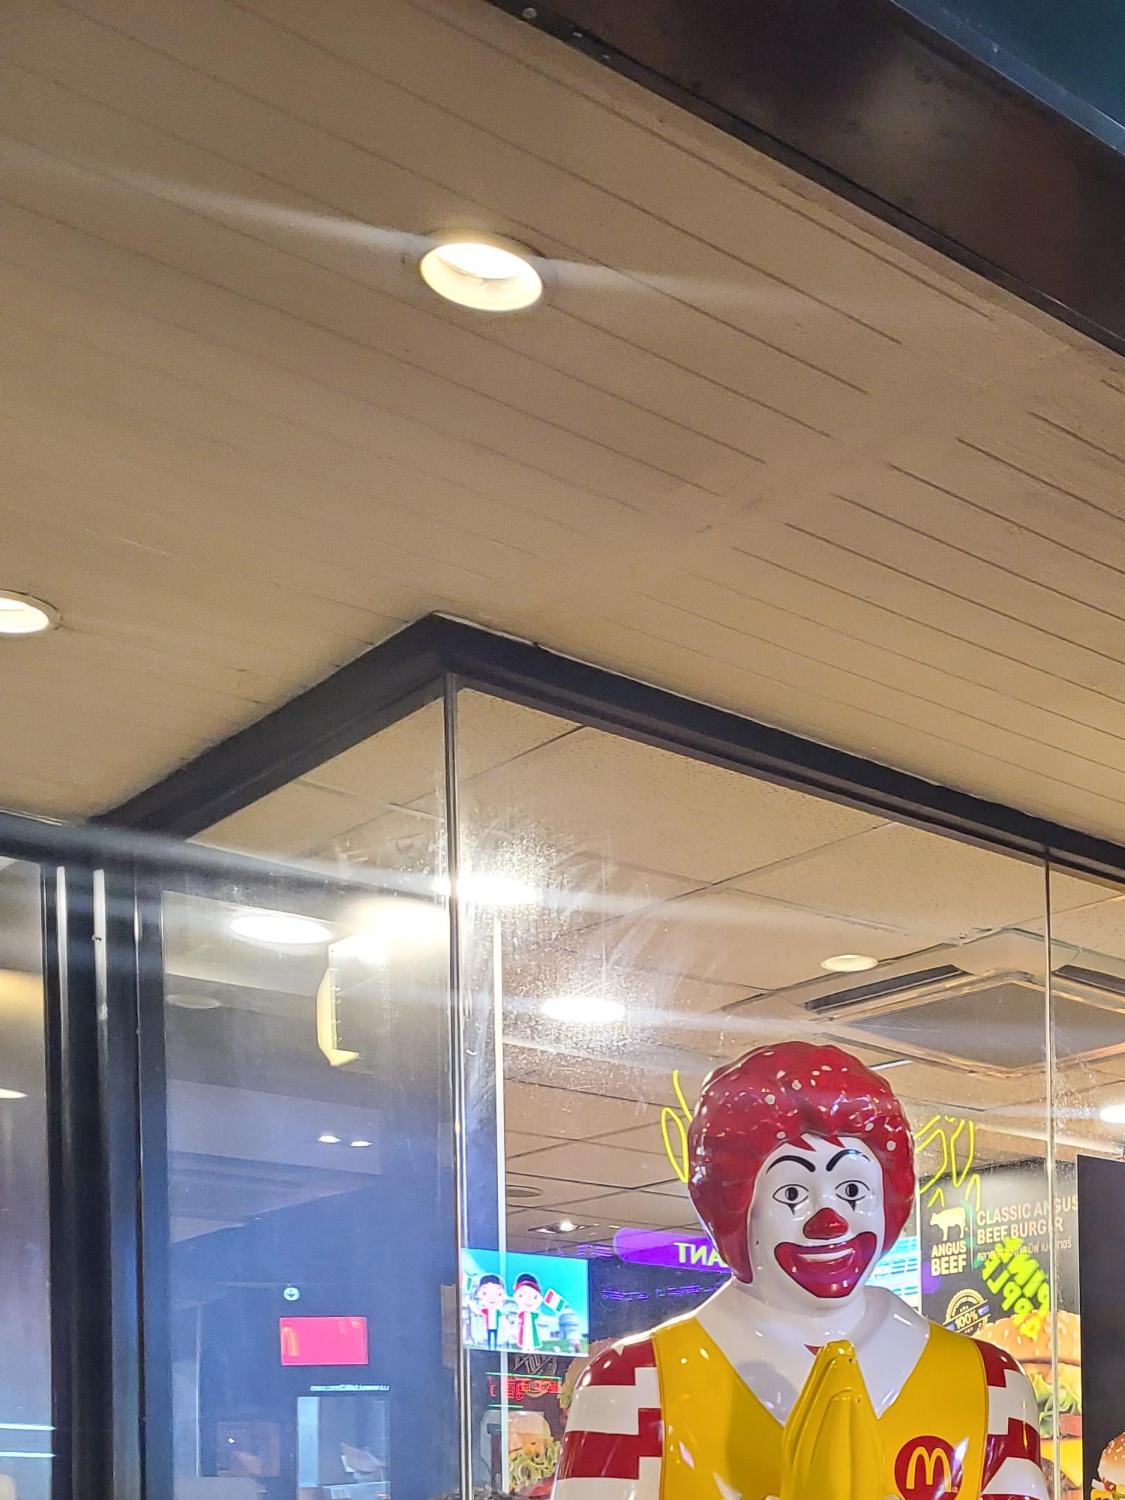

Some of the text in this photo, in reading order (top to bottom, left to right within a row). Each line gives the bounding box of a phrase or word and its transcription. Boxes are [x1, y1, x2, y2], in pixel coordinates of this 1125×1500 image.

[976, 1205, 1032, 1226] CLASSIC
[977, 1216, 1064, 1245] BEEF BURGR
[931, 1240, 967, 1258] ANGUS
[931, 1254, 967, 1276] BEEF
